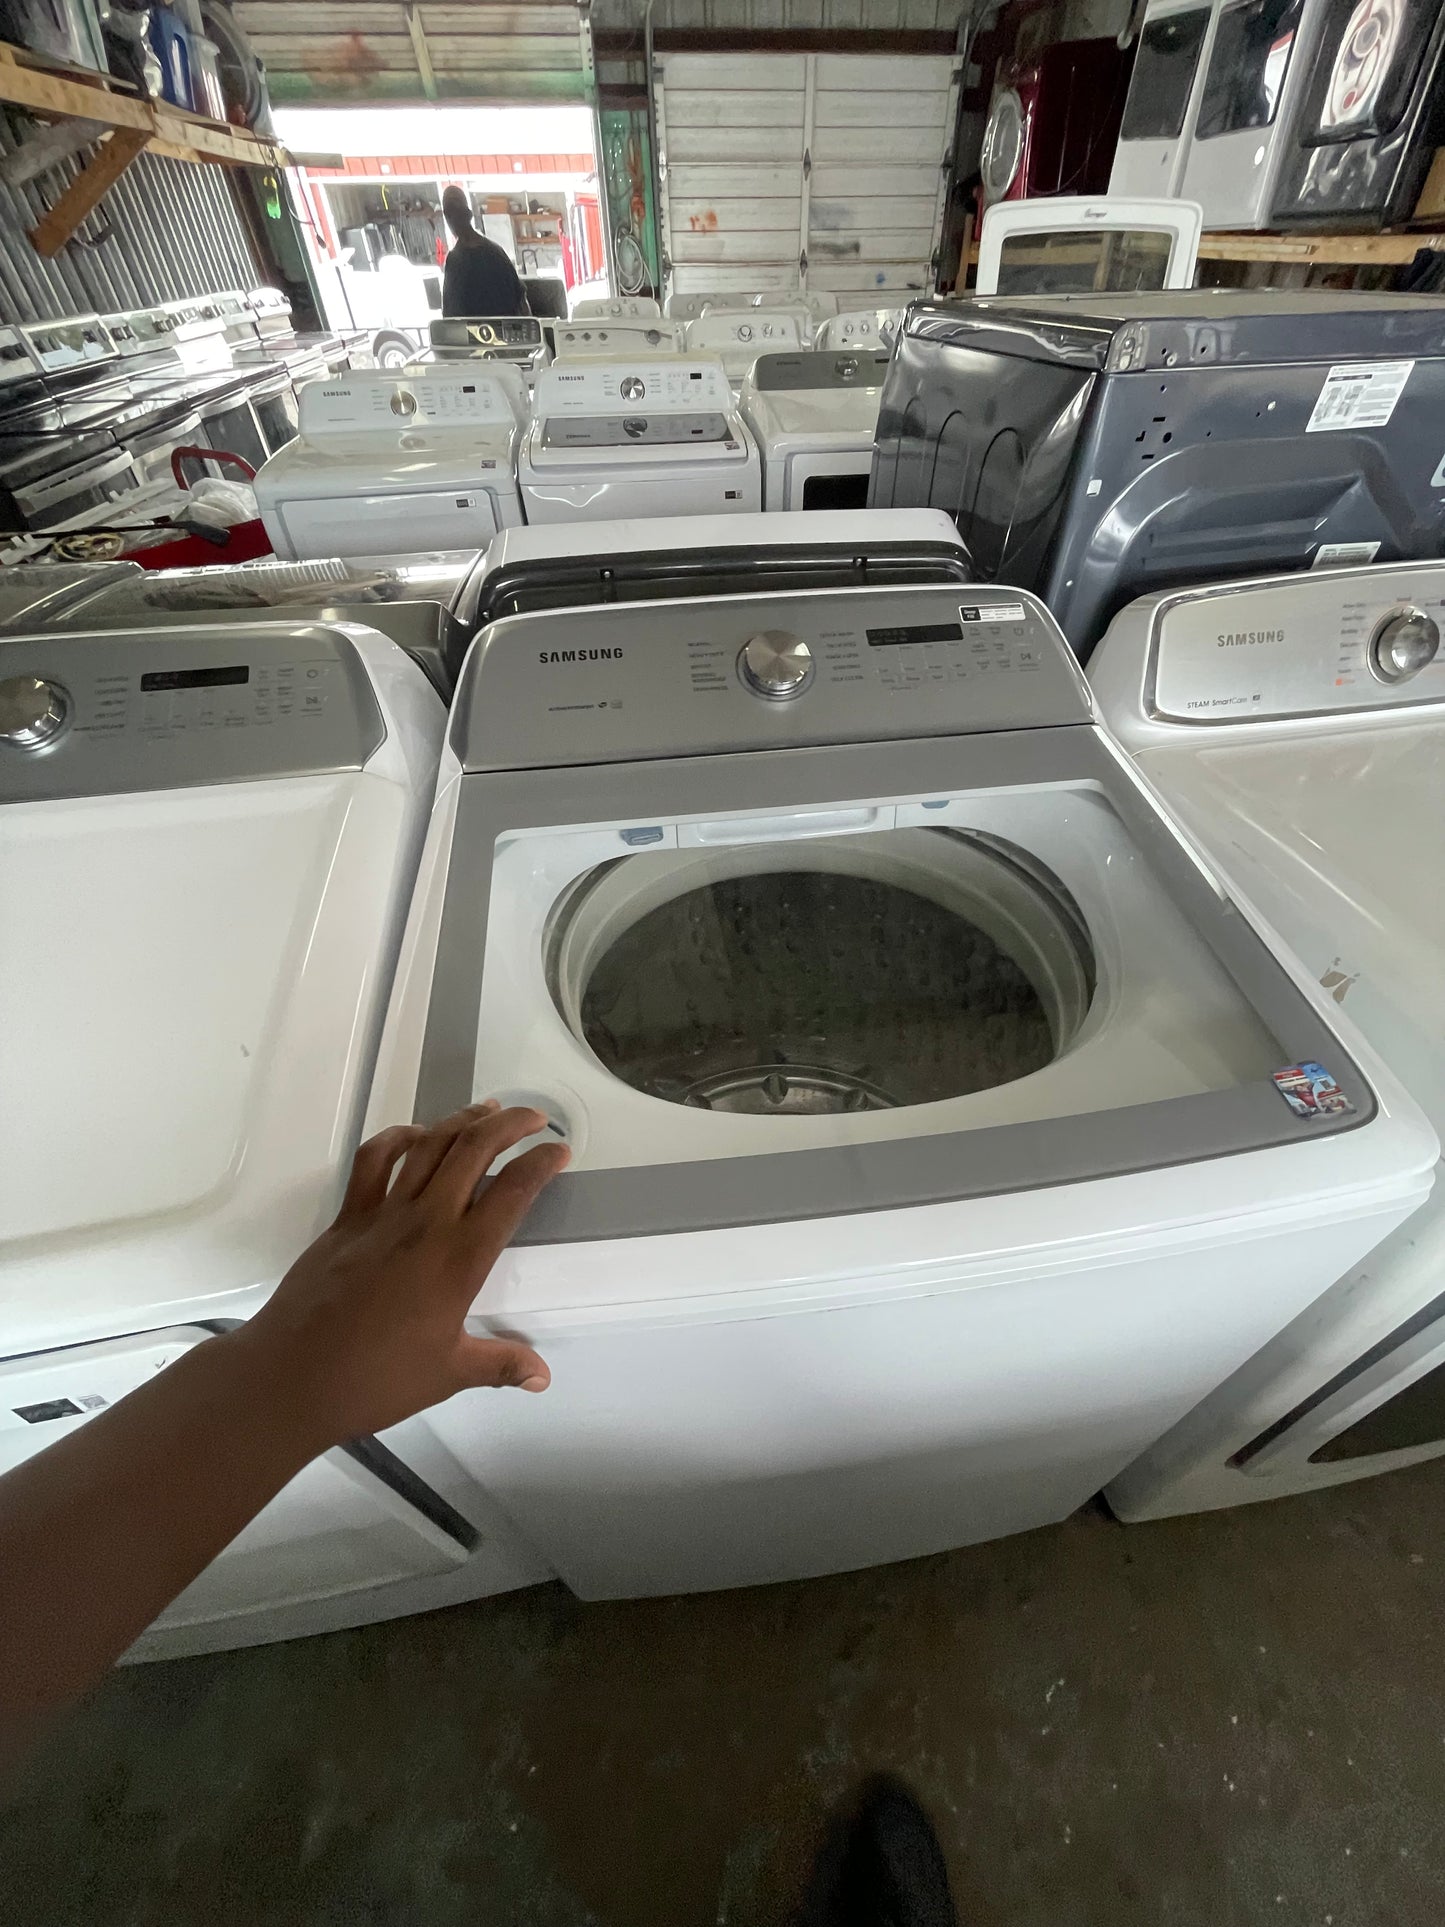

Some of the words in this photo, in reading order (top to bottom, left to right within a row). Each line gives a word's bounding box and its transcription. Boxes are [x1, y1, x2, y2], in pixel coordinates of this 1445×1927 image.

[1217, 629, 1285, 648] SAMSUNG
[539, 647, 624, 664] SAMSUNG
[1187, 699, 1210, 709] STEAM
